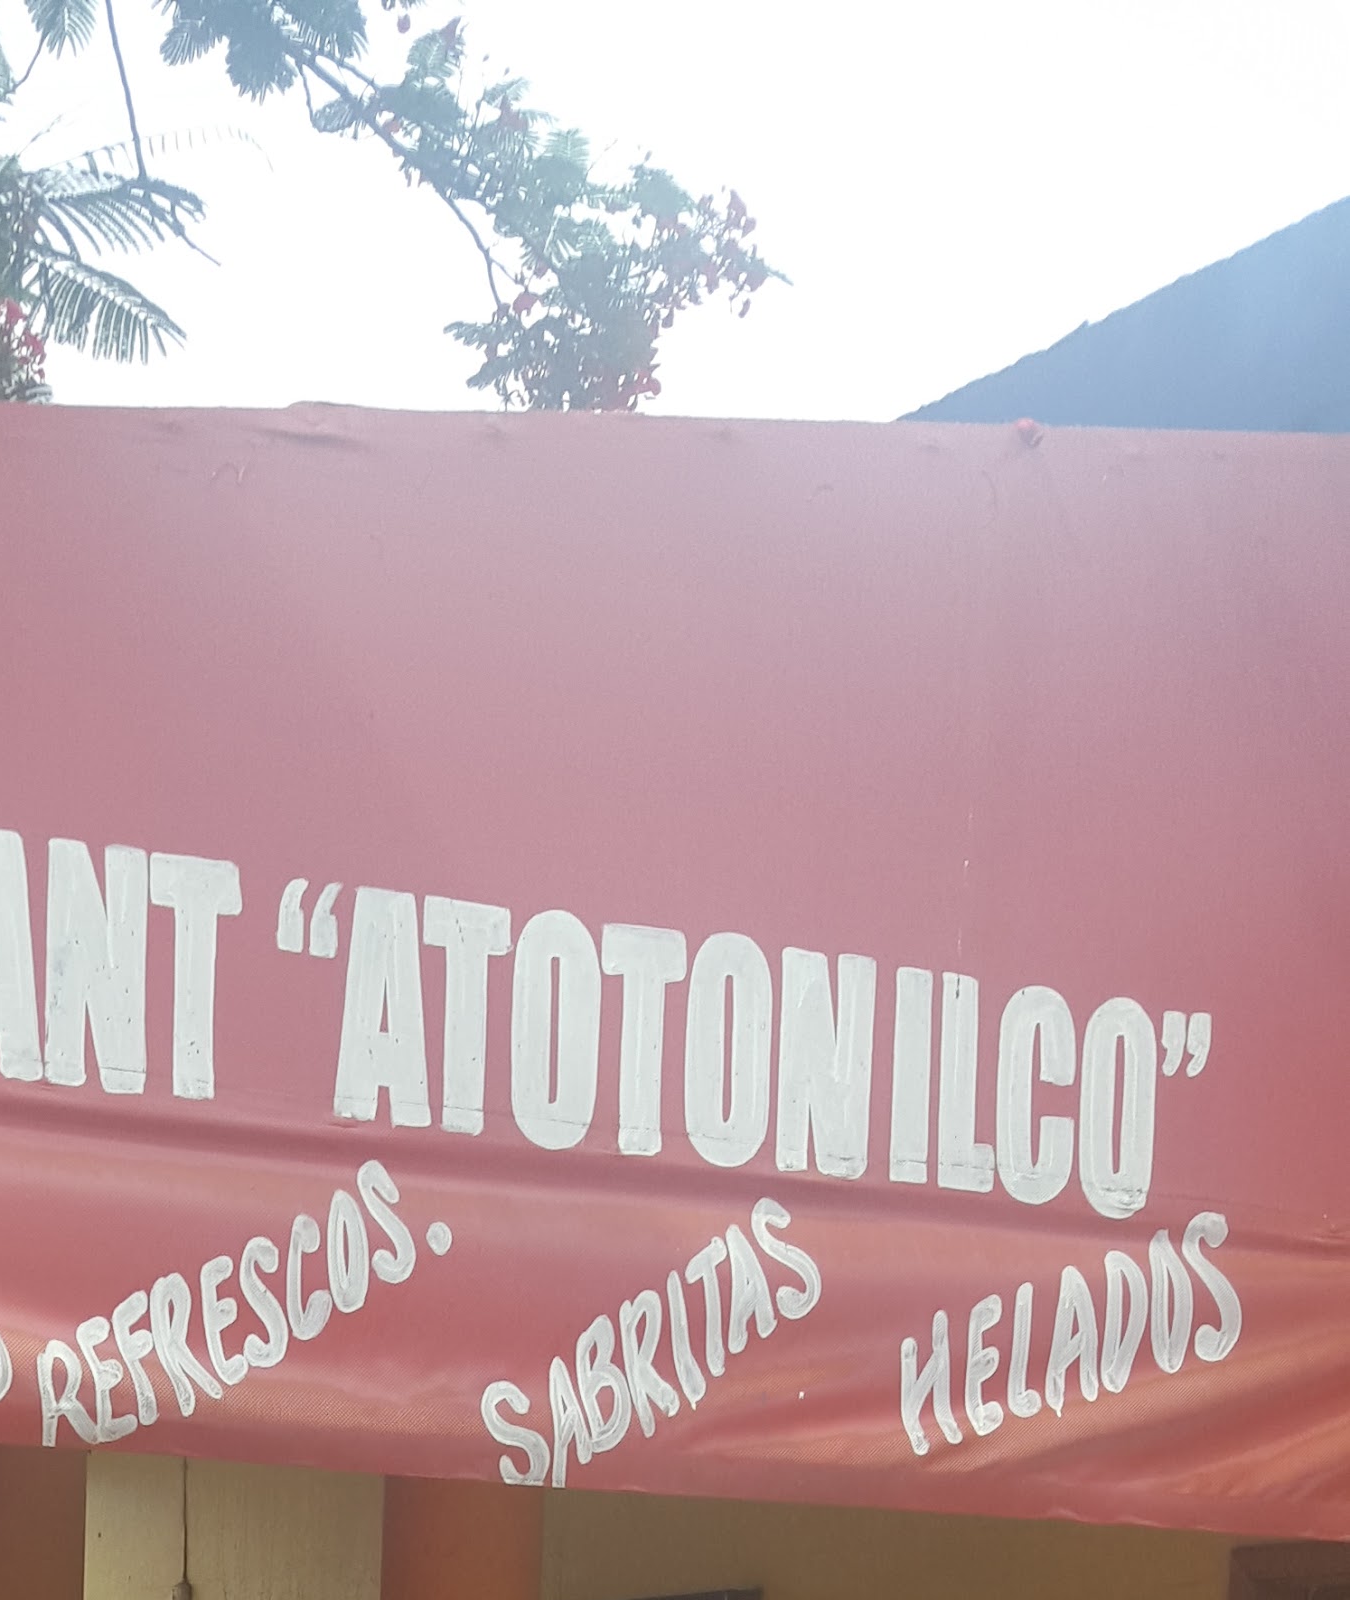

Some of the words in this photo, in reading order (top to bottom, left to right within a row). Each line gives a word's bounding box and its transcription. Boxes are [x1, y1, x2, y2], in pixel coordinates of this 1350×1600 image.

[39, 1159, 452, 1447] REFRESCOS.
[479, 1196, 822, 1488] SABRITAS
[900, 1211, 1242, 1456] HELADOS
